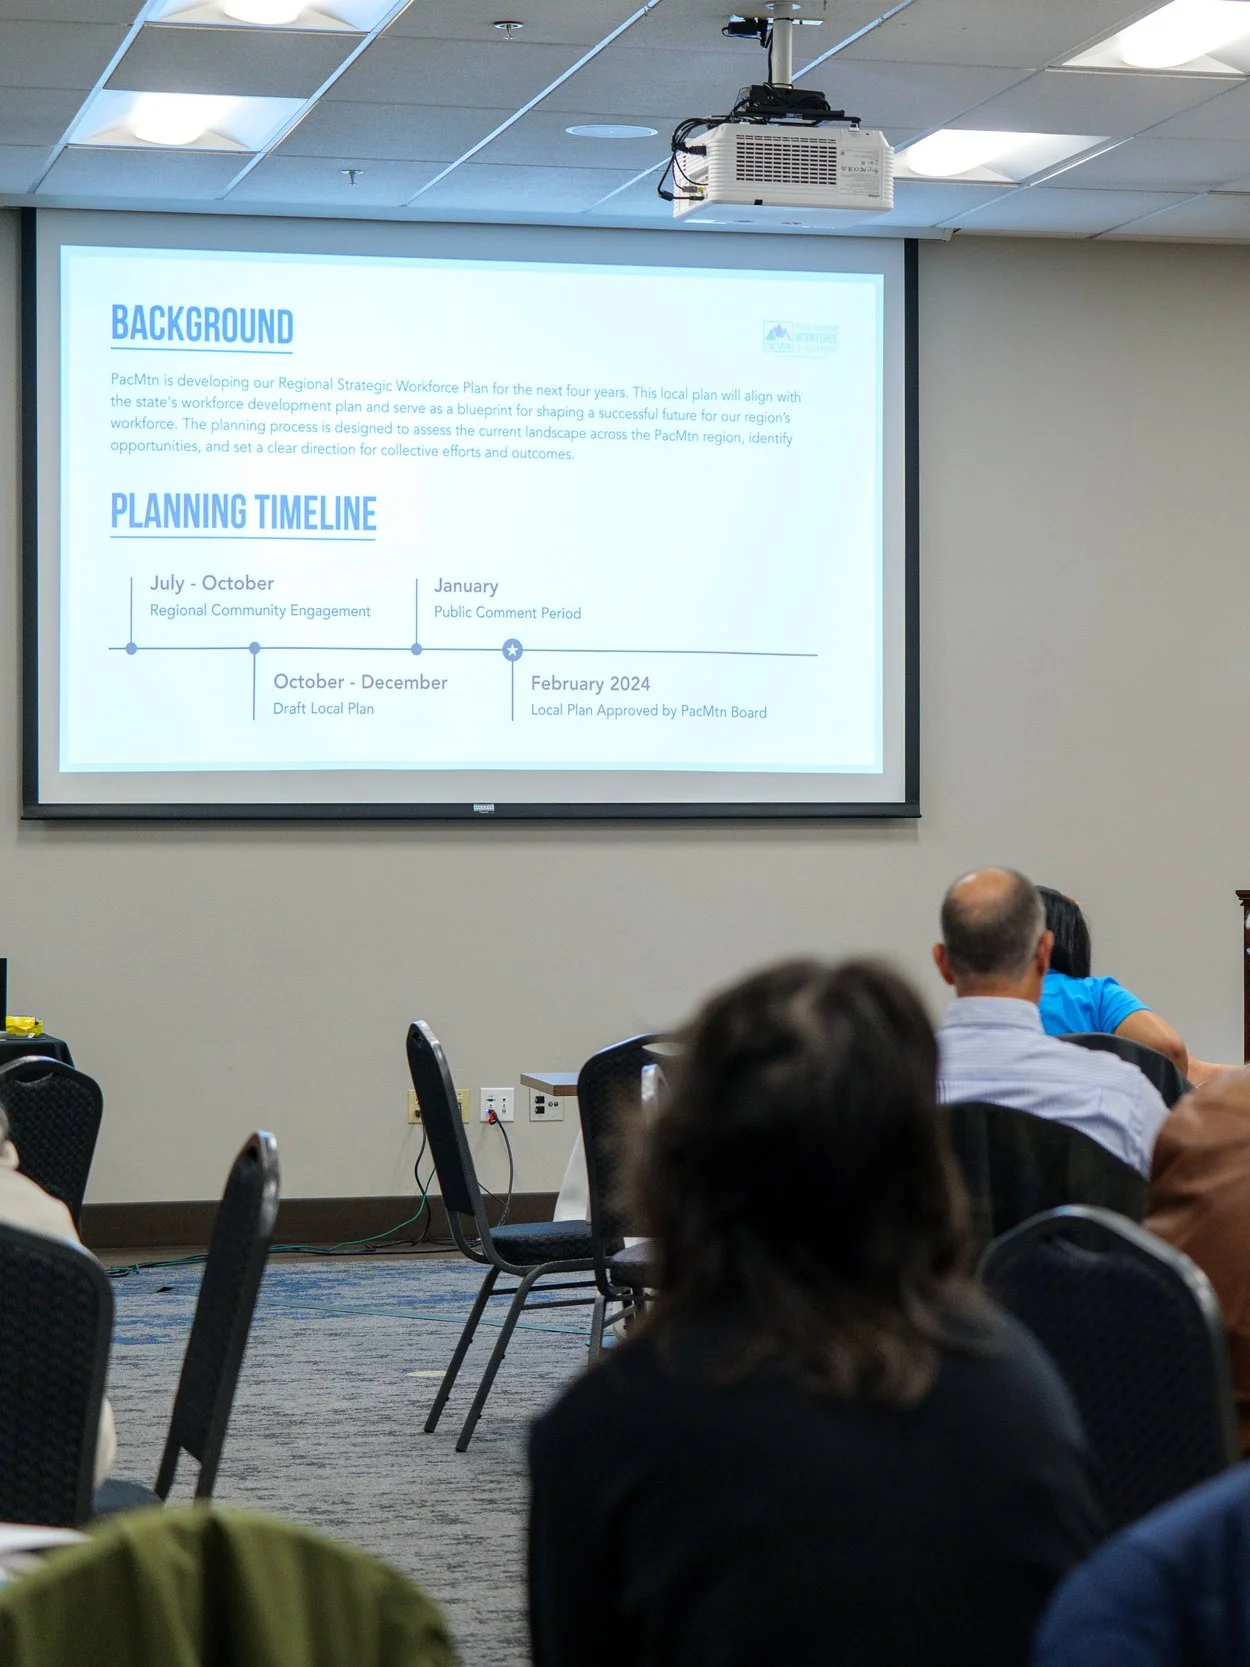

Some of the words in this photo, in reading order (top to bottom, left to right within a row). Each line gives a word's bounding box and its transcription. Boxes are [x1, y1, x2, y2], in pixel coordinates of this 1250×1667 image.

[112, 304, 293, 344] BACKGROUND
[112, 373, 159, 386] PacMtn
[164, 374, 174, 386] is
[177, 374, 249, 392] developing
[254, 379, 275, 390] our
[279, 377, 333, 392] Regional
[336, 378, 392, 395] Strategic
[396, 380, 459, 393] Workforce
[464, 381, 488, 394] Plan
[492, 382, 510, 395] for
[512, 383, 533, 396] the
[537, 386, 563, 397] next
[565, 384, 590, 397] four
[594, 388, 628, 400] years.
[632, 386, 657, 400] This
[661, 387, 688, 400] local
[692, 388, 717, 404] plan
[721, 389, 741, 401] will
[744, 390, 772, 405] align
[777, 390, 802, 404] with
[110, 394, 132, 408] the
[181, 395, 244, 410] workforce
[248, 397, 331, 414] development
[336, 398, 362, 414] plan
[366, 400, 389, 414] and
[393, 404, 425, 415] serve
[430, 404, 442, 415] as
[446, 406, 453, 415] a
[457, 402, 513, 420] blueprint
[516, 401, 532, 416] for
[536, 405, 584, 422] shaping
[588, 408, 595, 418] a
[598, 407, 658, 421] successful
[662, 408, 697, 422] future
[701, 408, 718, 423] for
[721, 413, 741, 423] our
[110, 416, 178, 431] workforce.
[182, 415, 206, 431] The
[211, 417, 266, 436] planning
[270, 421, 318, 436] process
[322, 419, 331, 434] is
[335, 421, 392, 437] designed
[397, 423, 409, 436] to
[413, 427, 452, 437] assess
[455, 423, 475, 437] the
[479, 427, 522, 438] current
[525, 425, 586, 440] landscape
[590, 429, 628, 440] across
[632, 428, 650, 442] the
[654, 428, 699, 443] PacMtn
[703, 430, 744, 446] region,
[749, 431, 792, 447] identify
[111, 440, 201, 455] opportunities,
[206, 440, 229, 452] and
[233, 442, 252, 453] set
[256, 444, 264, 453] a
[268, 441, 297, 454] clear
[301, 442, 355, 455] direction
[360, 442, 377, 455] for
[381, 443, 439, 456] collective
[442, 444, 482, 458] efforts
[484, 446, 508, 458] and
[512, 449, 574, 460] outcomes.
[112, 492, 247, 529] PLANNING
[254, 494, 377, 531] TIMELINE
[150, 576, 184, 595] July
[202, 576, 275, 590] October
[434, 578, 499, 597] January
[151, 603, 207, 619] Regional
[210, 604, 286, 620] Community
[291, 604, 371, 620] Engagement
[435, 605, 472, 618] Public
[476, 606, 537, 619] Comment
[542, 607, 581, 619] Period
[274, 675, 344, 689] October
[362, 675, 448, 689] December
[532, 676, 604, 695] February
[610, 676, 650, 691] 2024
[274, 701, 306, 714] Draft
[311, 702, 343, 714] Local
[348, 701, 374, 714] Plan
[532, 703, 563, 715] Local
[568, 703, 592, 716] Plan
[597, 704, 658, 720] Approved
[662, 704, 677, 720] by
[681, 704, 727, 718] PacMtn
[732, 706, 767, 719] Board
